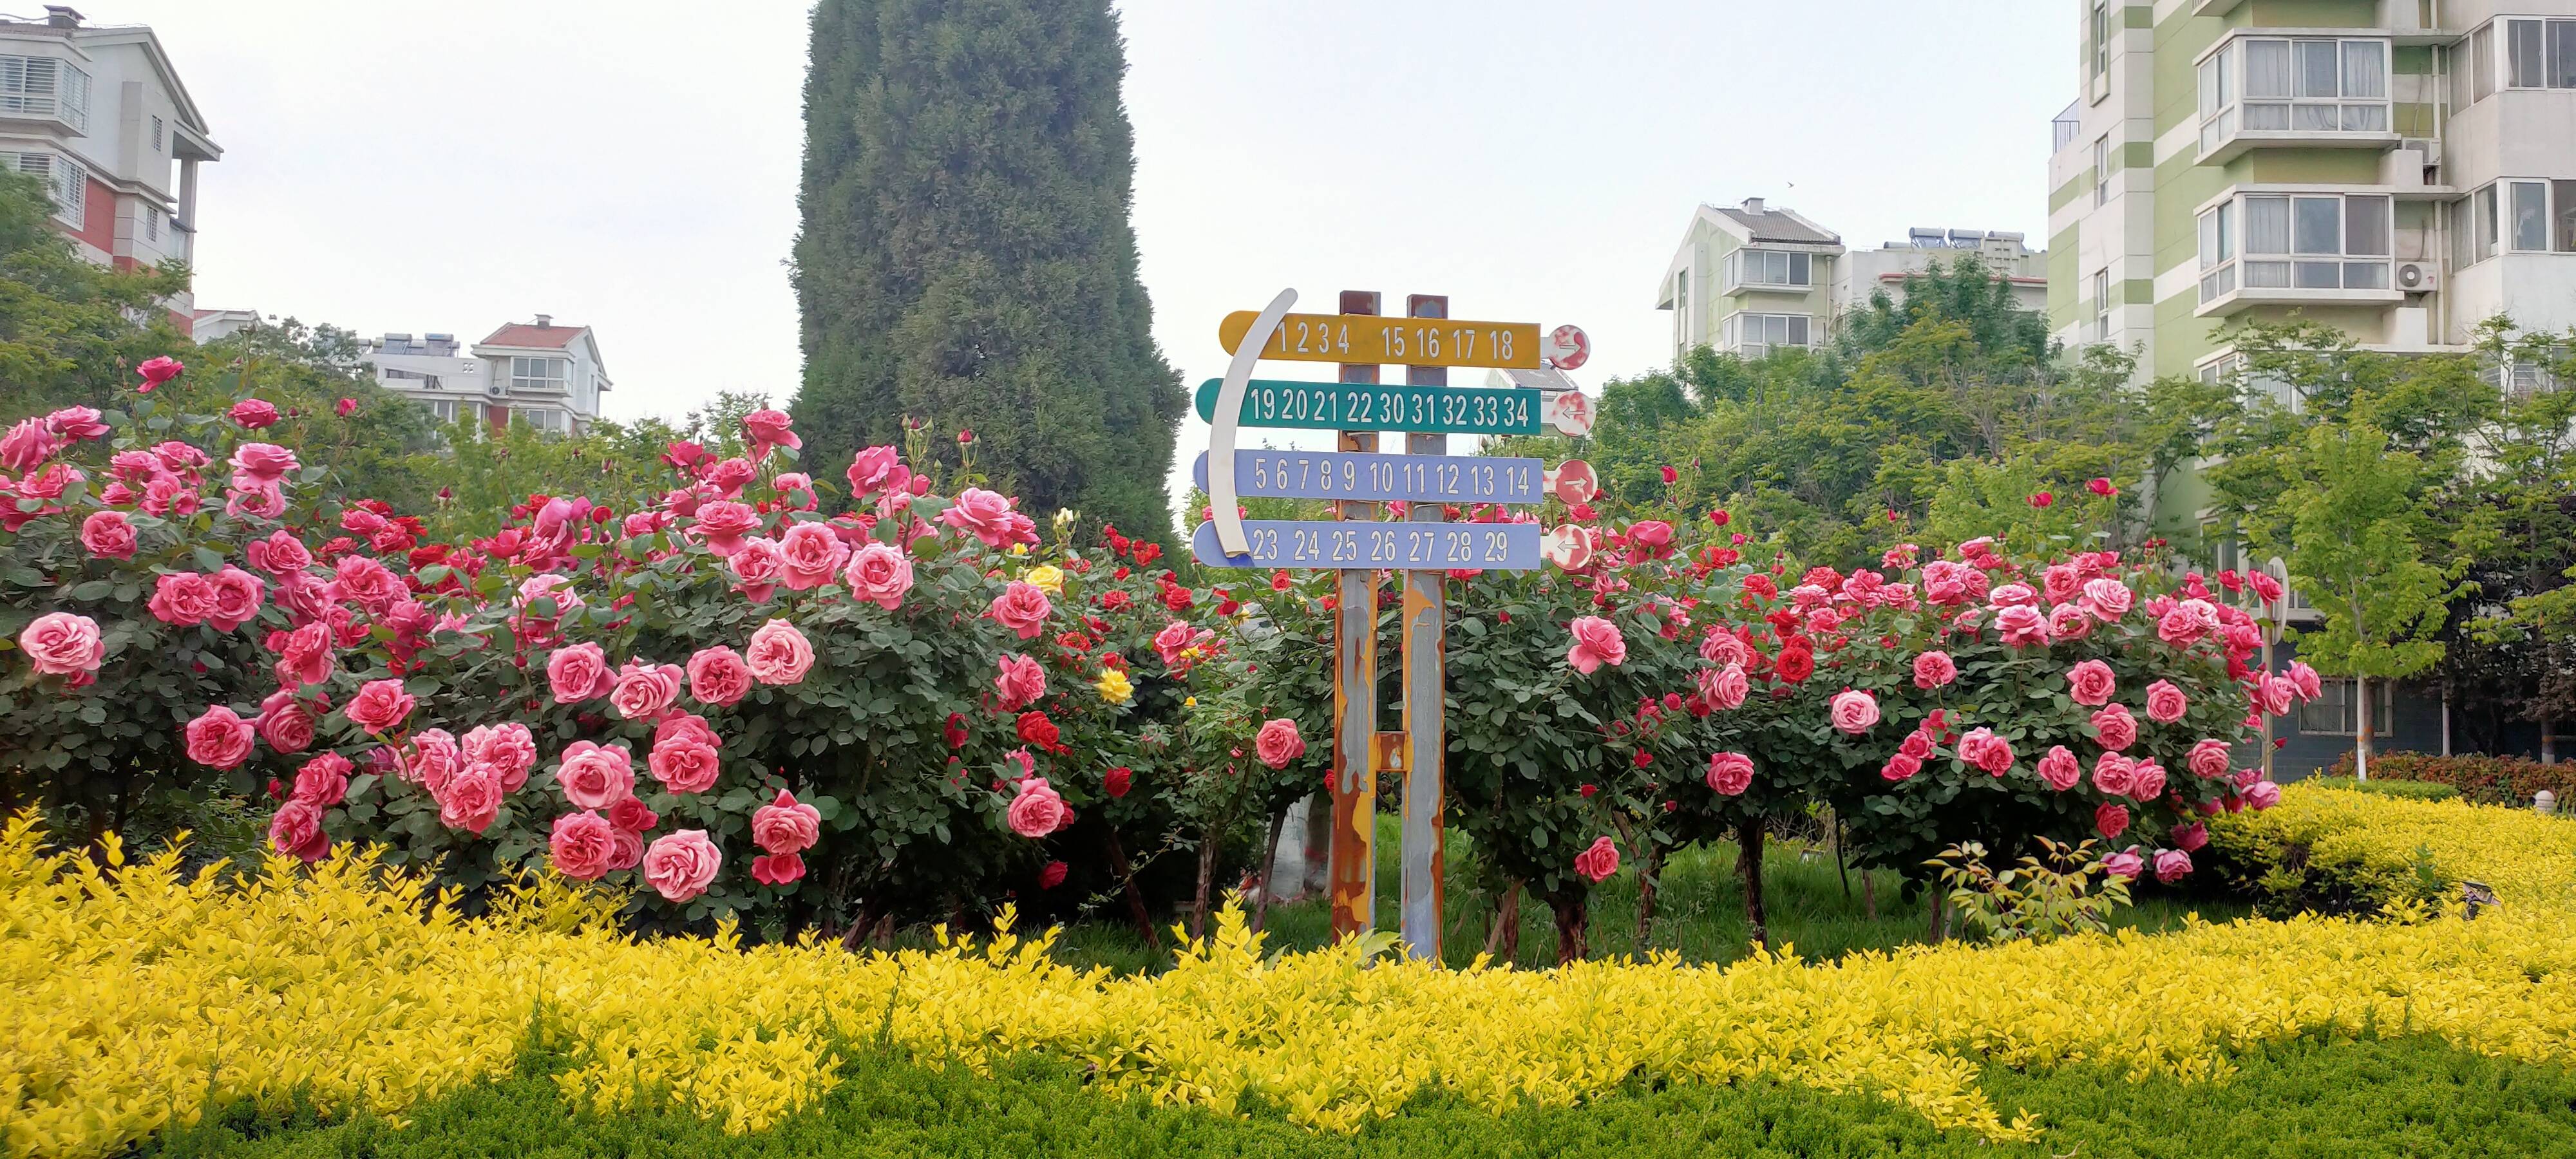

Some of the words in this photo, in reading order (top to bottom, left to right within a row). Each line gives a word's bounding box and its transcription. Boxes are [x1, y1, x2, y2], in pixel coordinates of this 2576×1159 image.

[1277, 321, 1287, 352] 1
[1297, 321, 1309, 353] 2
[1318, 323, 1330, 353] 3
[1338, 324, 1350, 354] 4
[1381, 326, 1405, 357] 15
[1416, 327, 1439, 358] 16
[1452, 328, 1475, 359] 17
[1490, 330, 1513, 361] 18
[1251, 388, 1276, 420] 19
[1281, 388, 1308, 421] 20
[1314, 390, 1337, 422] 21
[1347, 391, 1373, 423] 22
[1379, 392, 1405, 424] 30
[1411, 393, 1435, 425] 31
[1442, 395, 1468, 426] 32
[1473, 395, 1498, 427] 33
[1503, 396, 1529, 428] 34
[1255, 458, 1267, 489] 5
[1276, 458, 1288, 490] 6
[1298, 459, 1309, 490] 7
[1320, 460, 1332, 491] 8
[1343, 460, 1355, 491] 9
[1369, 462, 1394, 493] 10
[1403, 462, 1425, 494] 11
[1436, 463, 1459, 495] 12
[1470, 464, 1495, 496] 13
[1506, 465, 1530, 496] 14
[1253, 528, 1278, 560] 23
[1293, 529, 1320, 561] 24
[1331, 529, 1358, 561] 25
[1370, 530, 1396, 561] 26
[1408, 531, 1435, 562] 27
[1446, 531, 1472, 562] 28
[1484, 531, 1508, 562] 29
